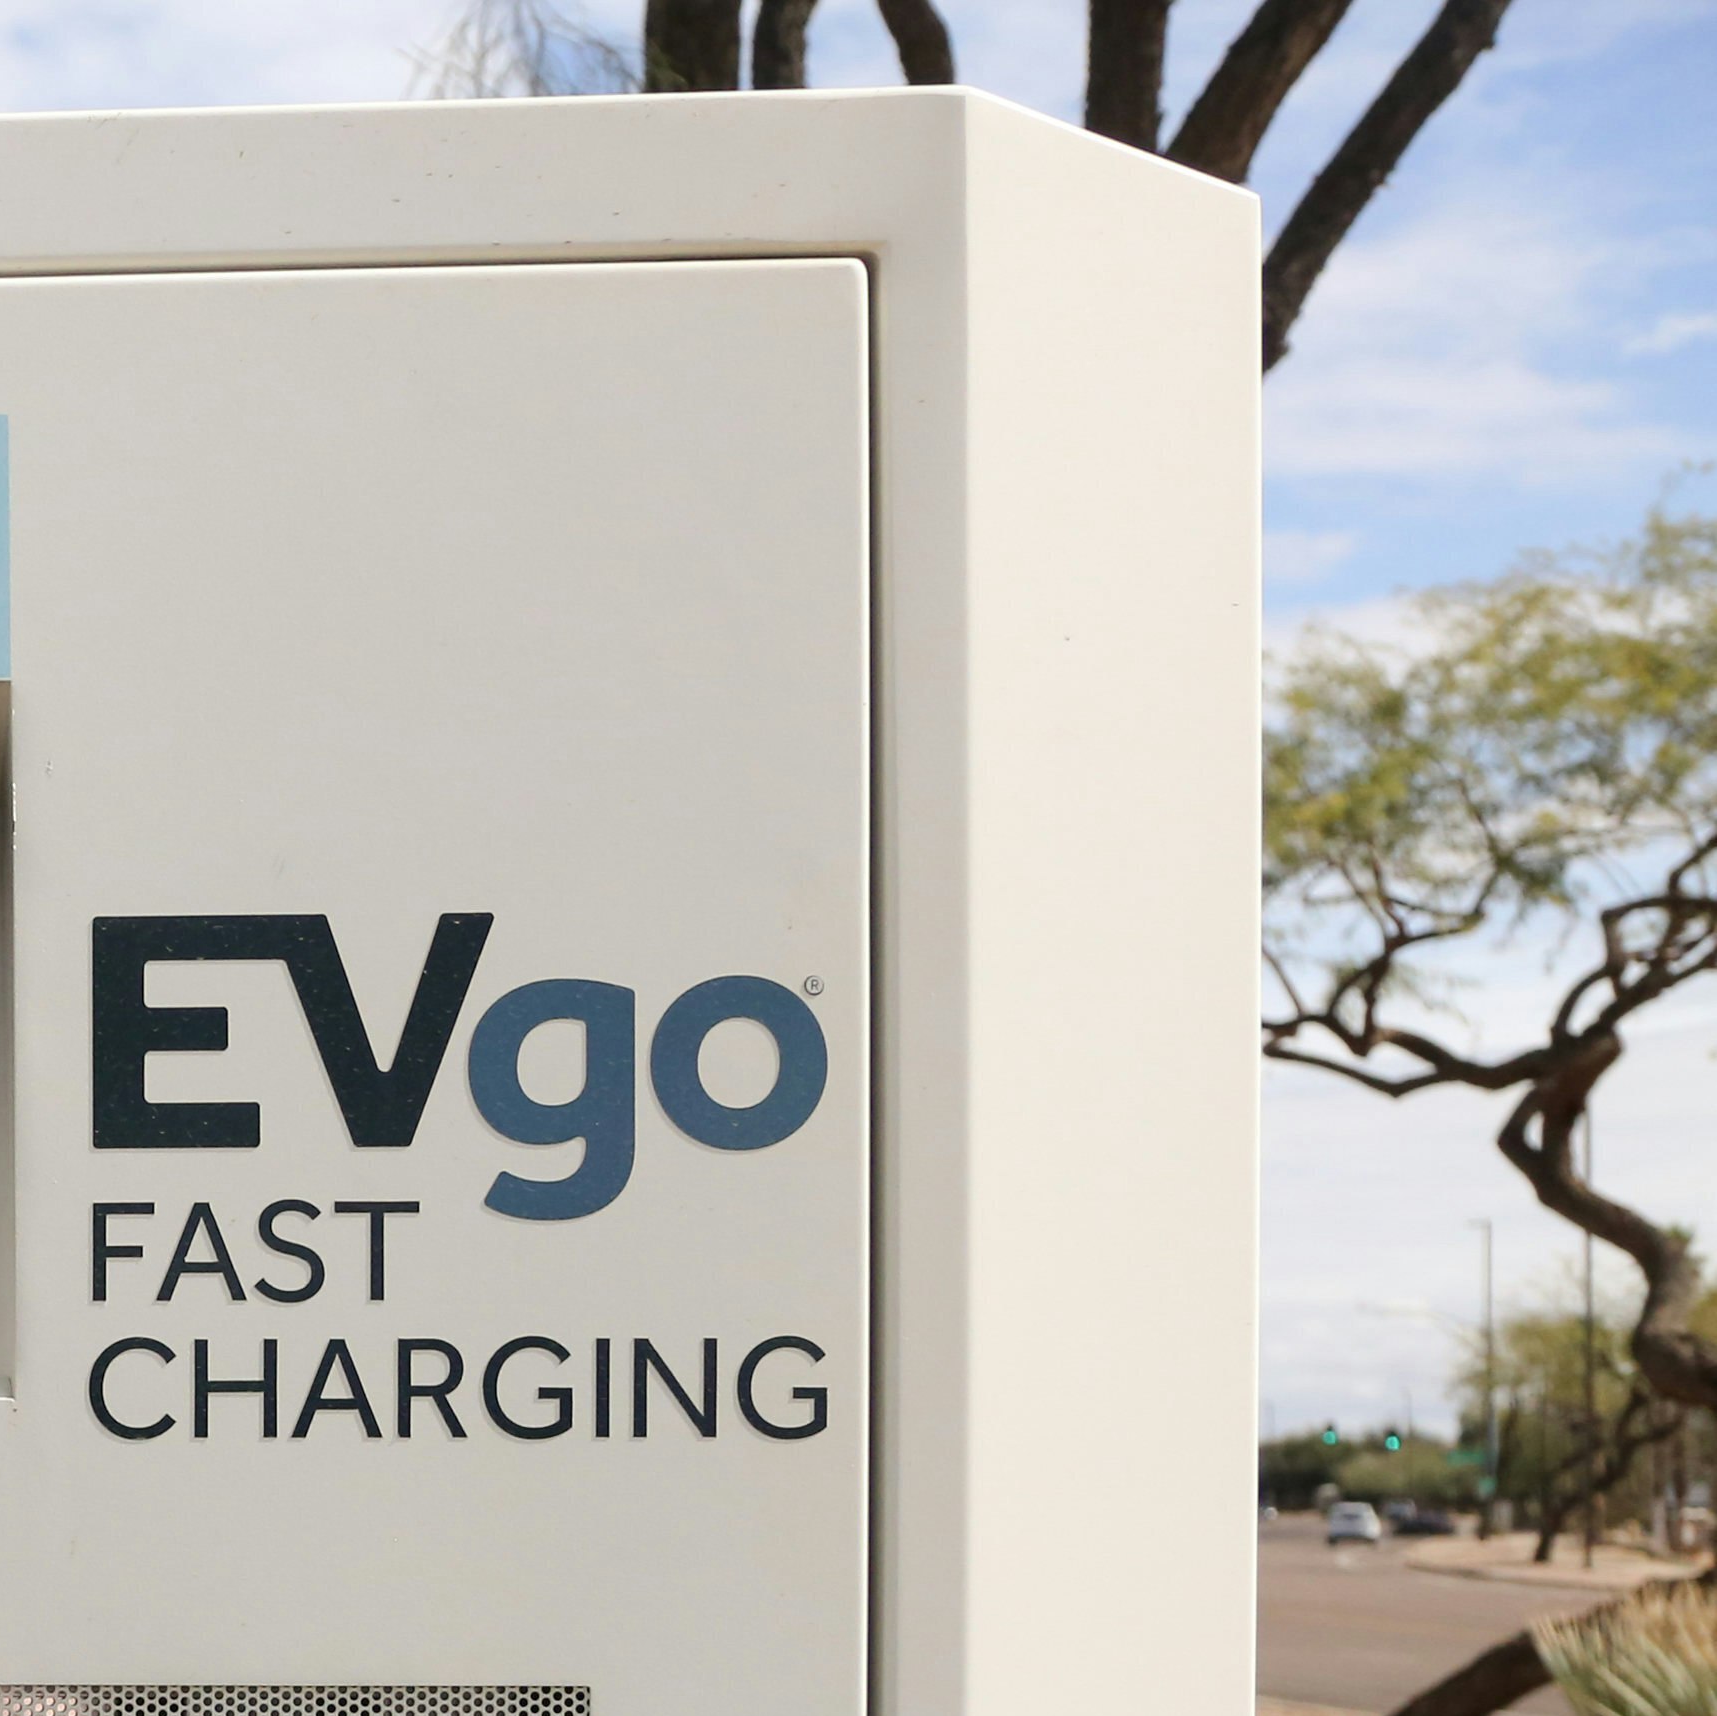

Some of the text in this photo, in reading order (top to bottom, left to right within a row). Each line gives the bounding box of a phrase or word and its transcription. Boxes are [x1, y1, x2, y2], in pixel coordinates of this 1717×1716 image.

[92, 912, 828, 1220] EVgo
[92, 1200, 420, 1302] FAST
[88, 1335, 828, 1439] CHARGING
